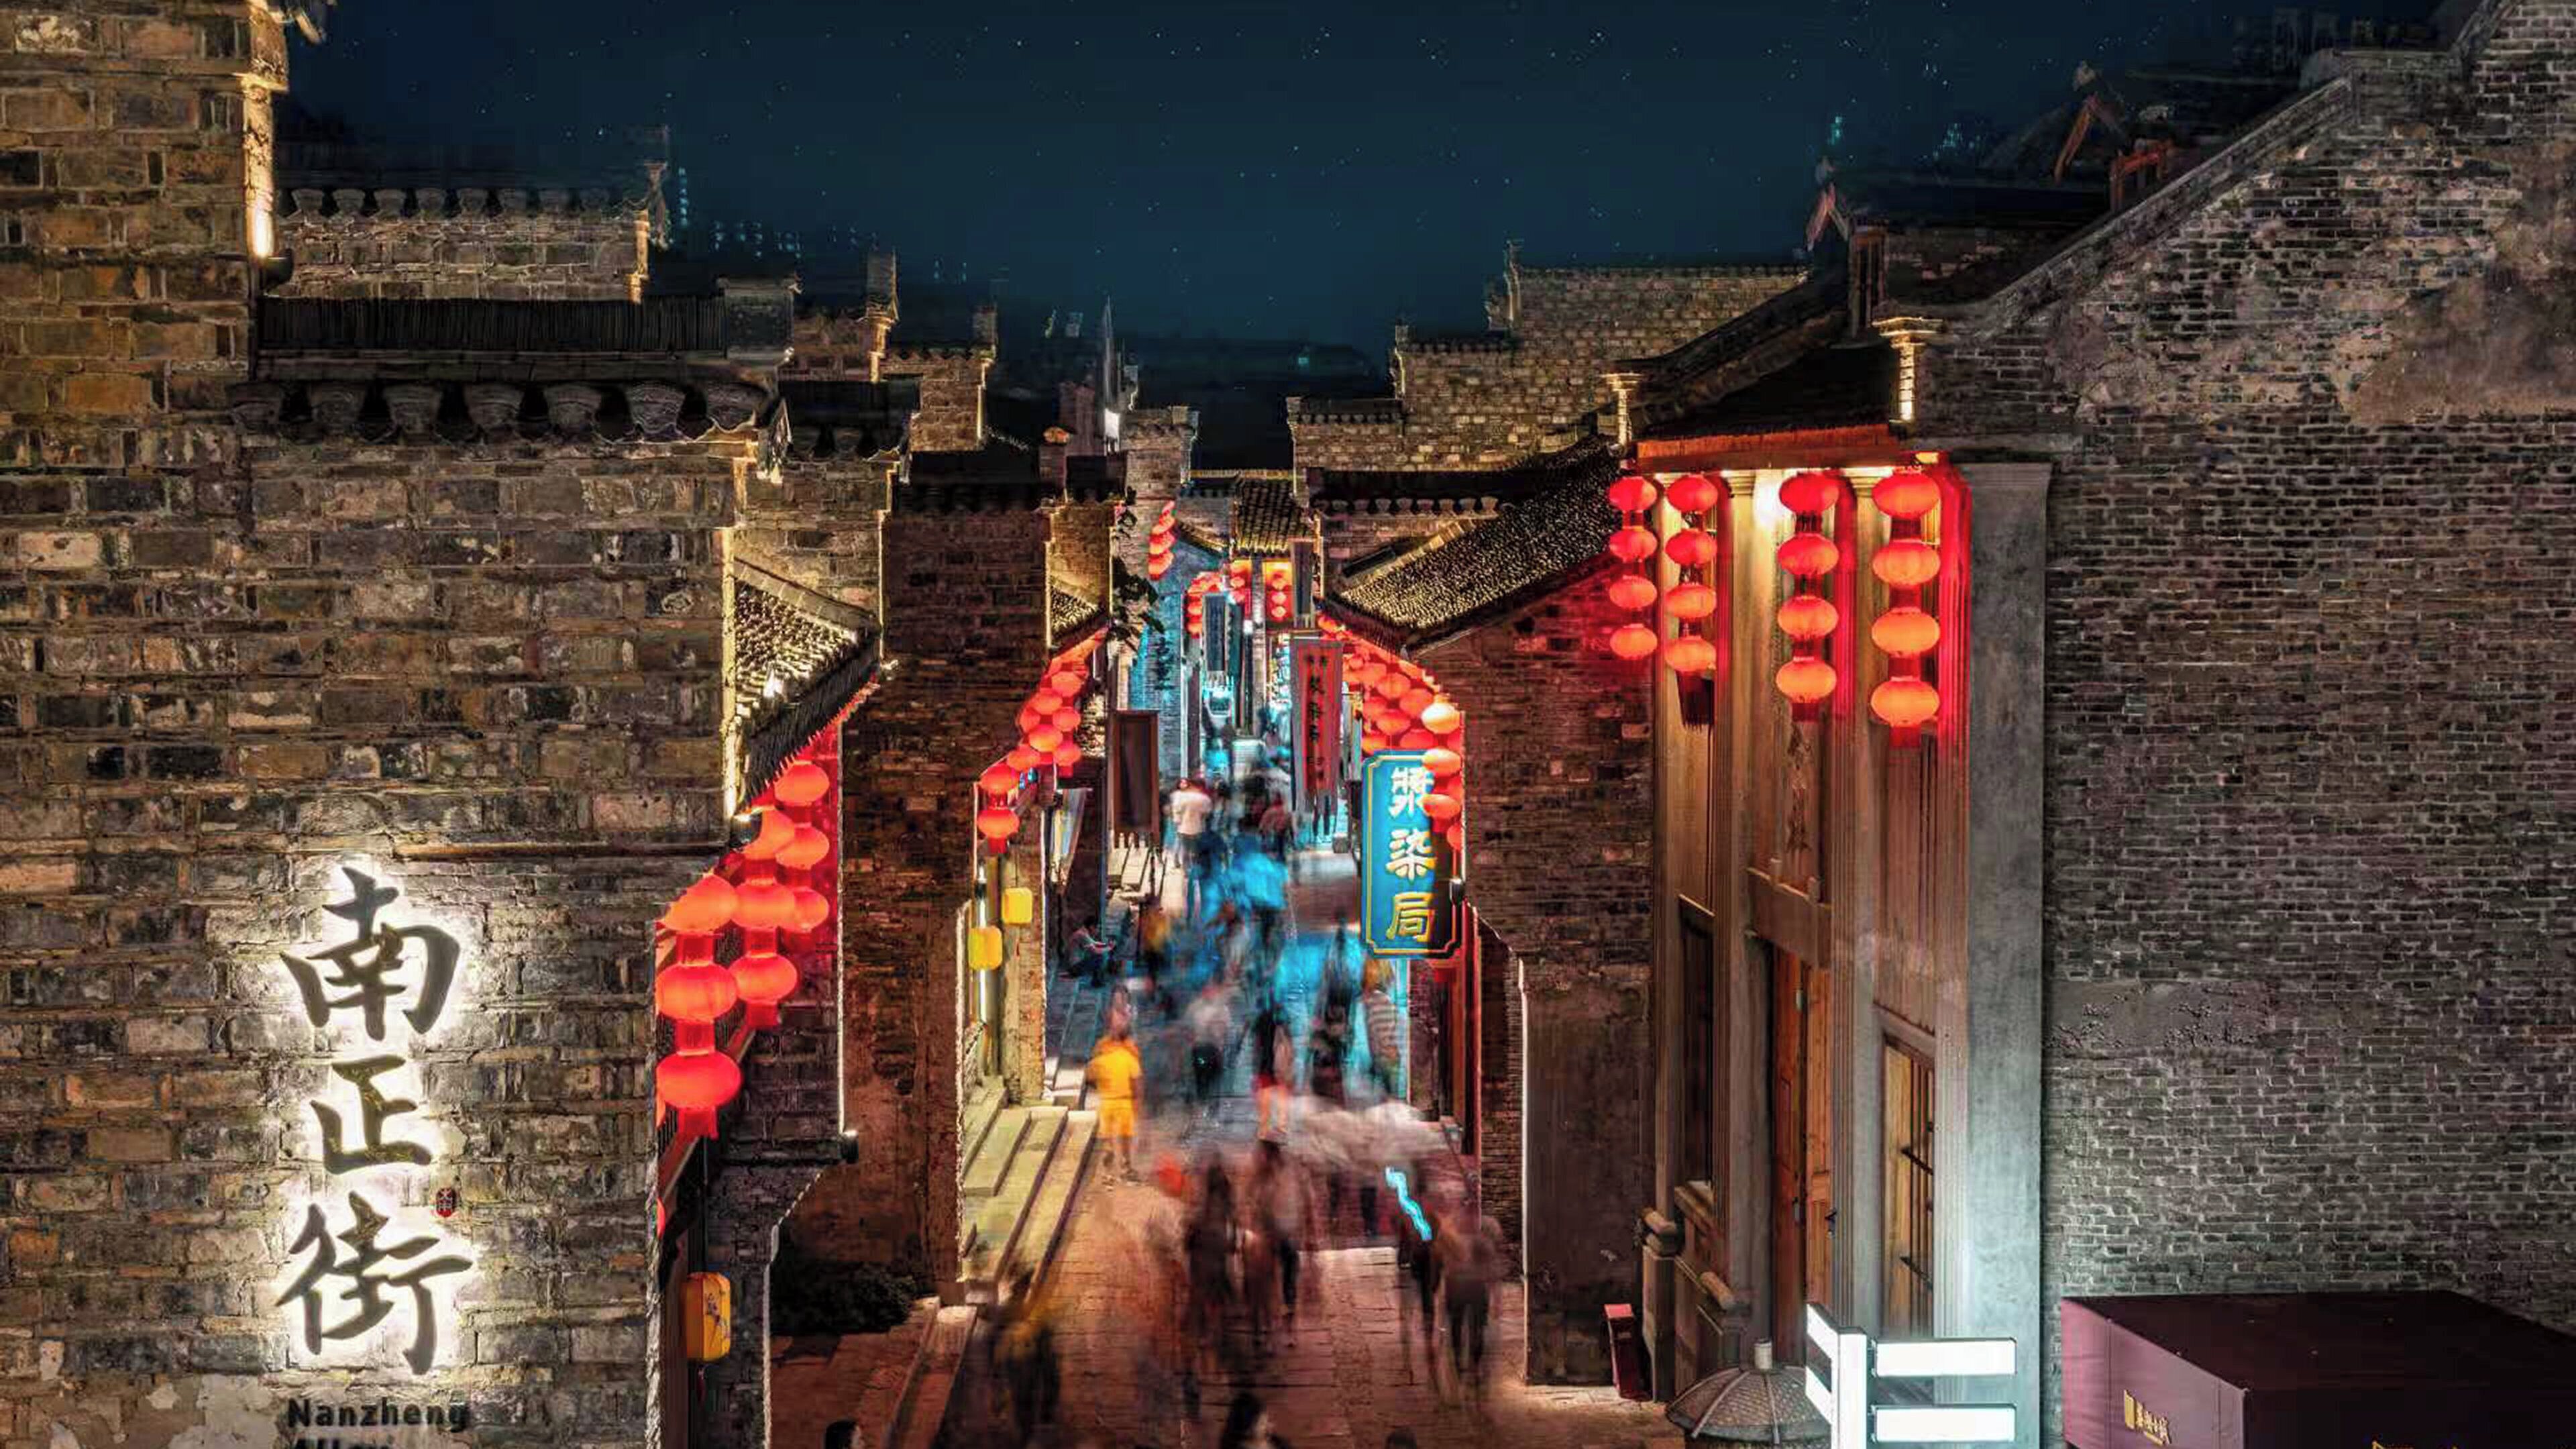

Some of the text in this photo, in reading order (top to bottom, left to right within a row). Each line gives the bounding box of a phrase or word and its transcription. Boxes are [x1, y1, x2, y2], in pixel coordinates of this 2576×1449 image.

[276, 866, 474, 1376] 南正街
[287, 1397, 468, 1433] Nanzheng
